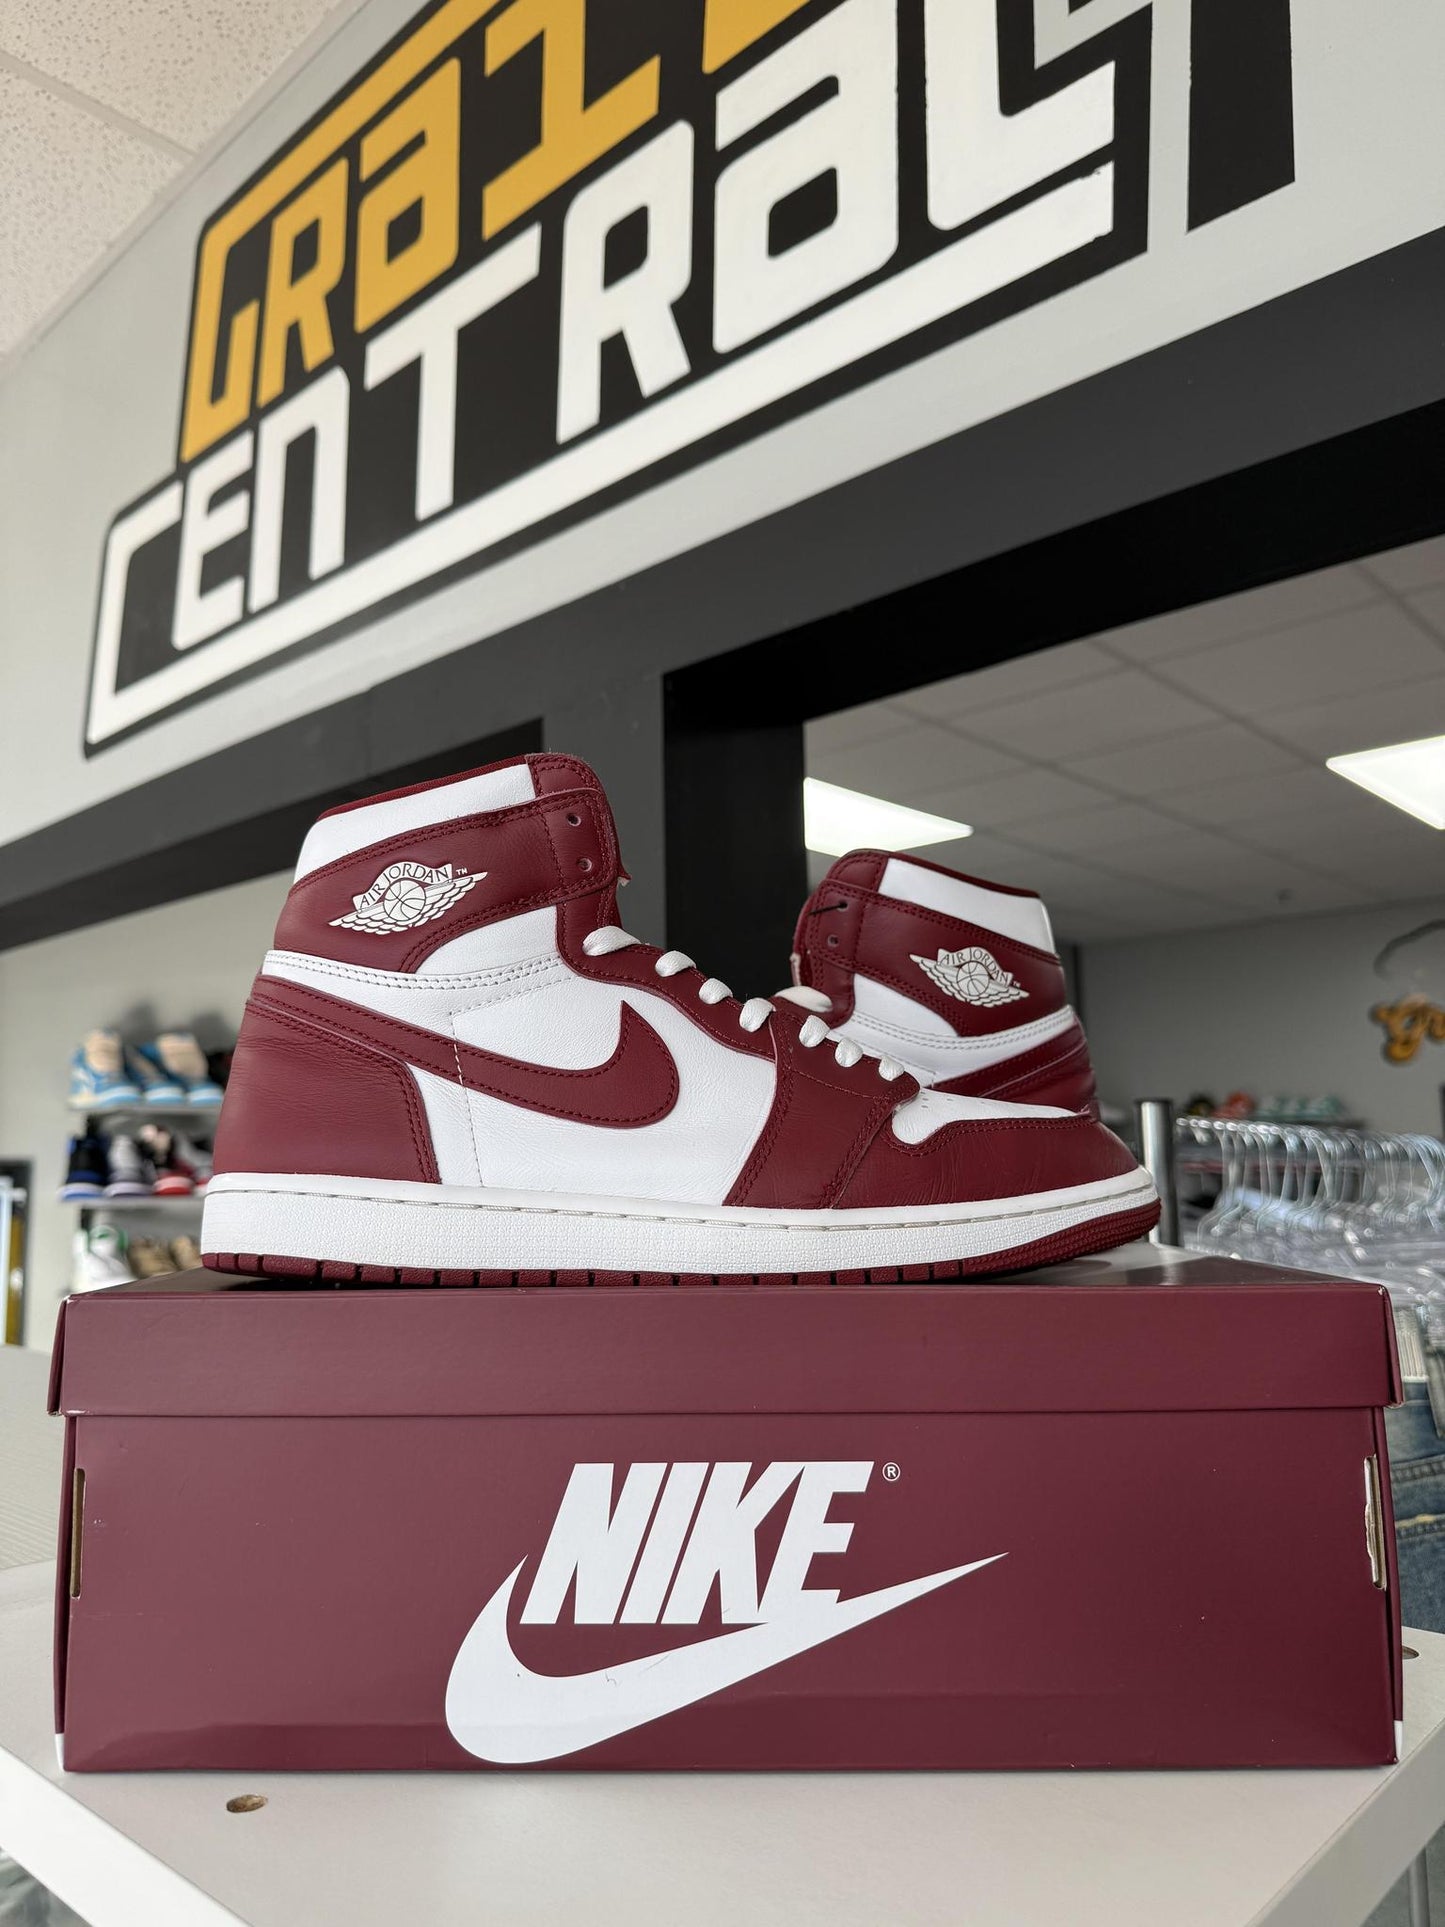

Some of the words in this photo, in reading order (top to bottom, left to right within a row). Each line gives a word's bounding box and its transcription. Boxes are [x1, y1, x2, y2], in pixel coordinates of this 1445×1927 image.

[358, 881, 386, 910] AIR
[382, 863, 450, 884] JORDAN
[937, 951, 966, 967] AIR
[968, 948, 1010, 987] JORDAN
[519, 1461, 874, 1625] NIKE
